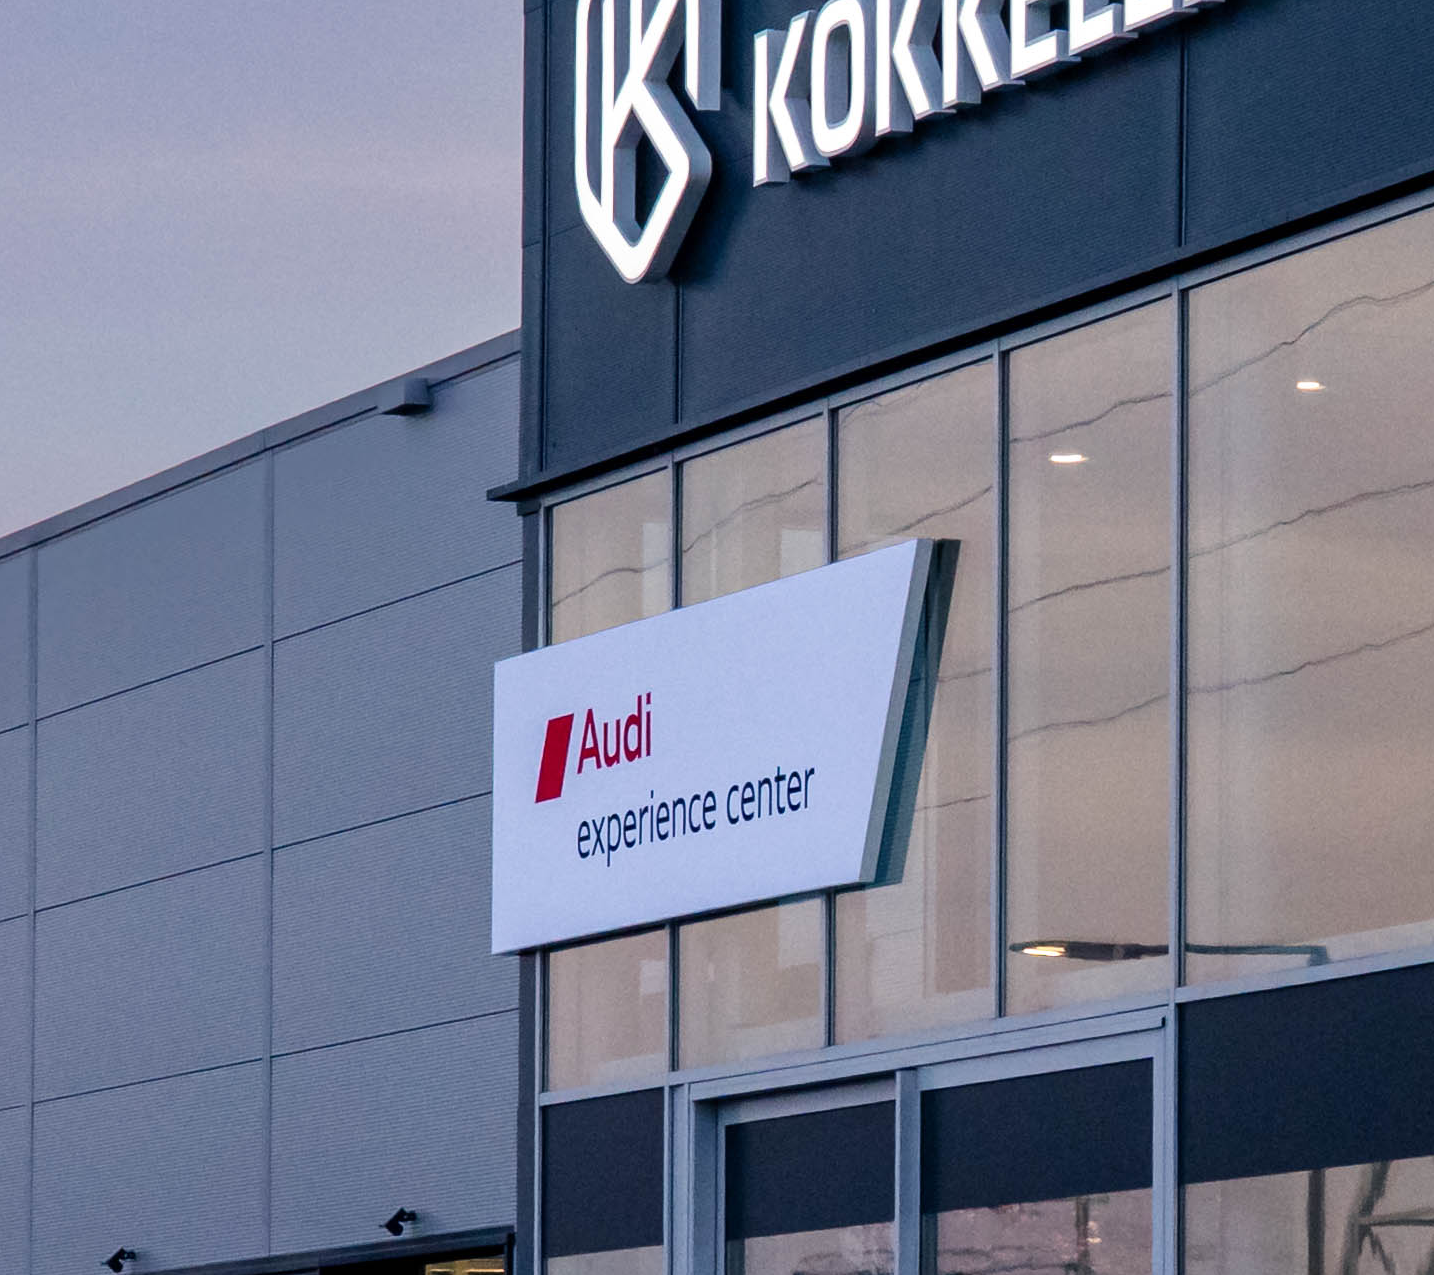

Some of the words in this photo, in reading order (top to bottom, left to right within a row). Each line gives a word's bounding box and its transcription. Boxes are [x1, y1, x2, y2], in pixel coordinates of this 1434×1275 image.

[576, 691, 653, 775] Audi
[576, 789, 717, 868] experience
[725, 766, 815, 826] center
